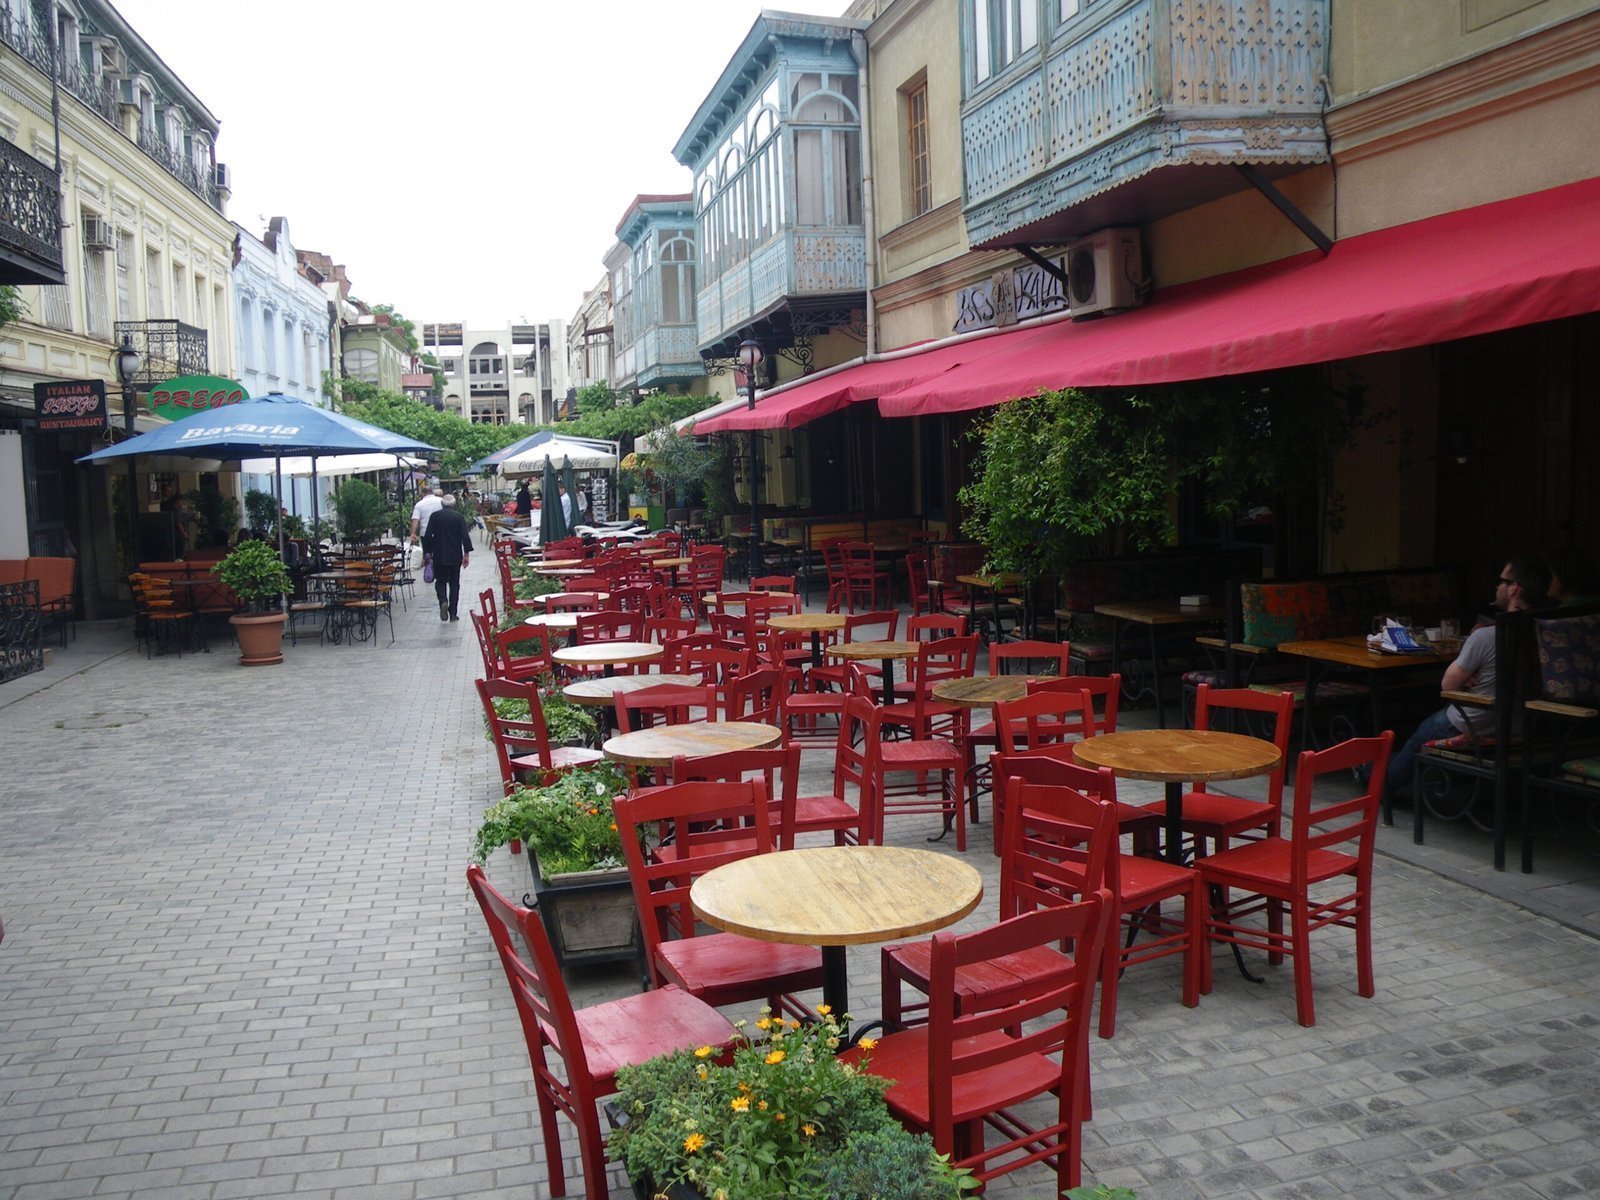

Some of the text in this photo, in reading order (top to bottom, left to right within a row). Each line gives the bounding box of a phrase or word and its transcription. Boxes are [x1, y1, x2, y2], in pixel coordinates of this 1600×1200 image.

[47, 385, 91, 395] ITALIAN
[41, 395, 99, 416] PREGO
[152, 389, 243, 409] PREGO
[40, 417, 104, 429] RESTAURANT
[181, 424, 300, 439] Bavaria
